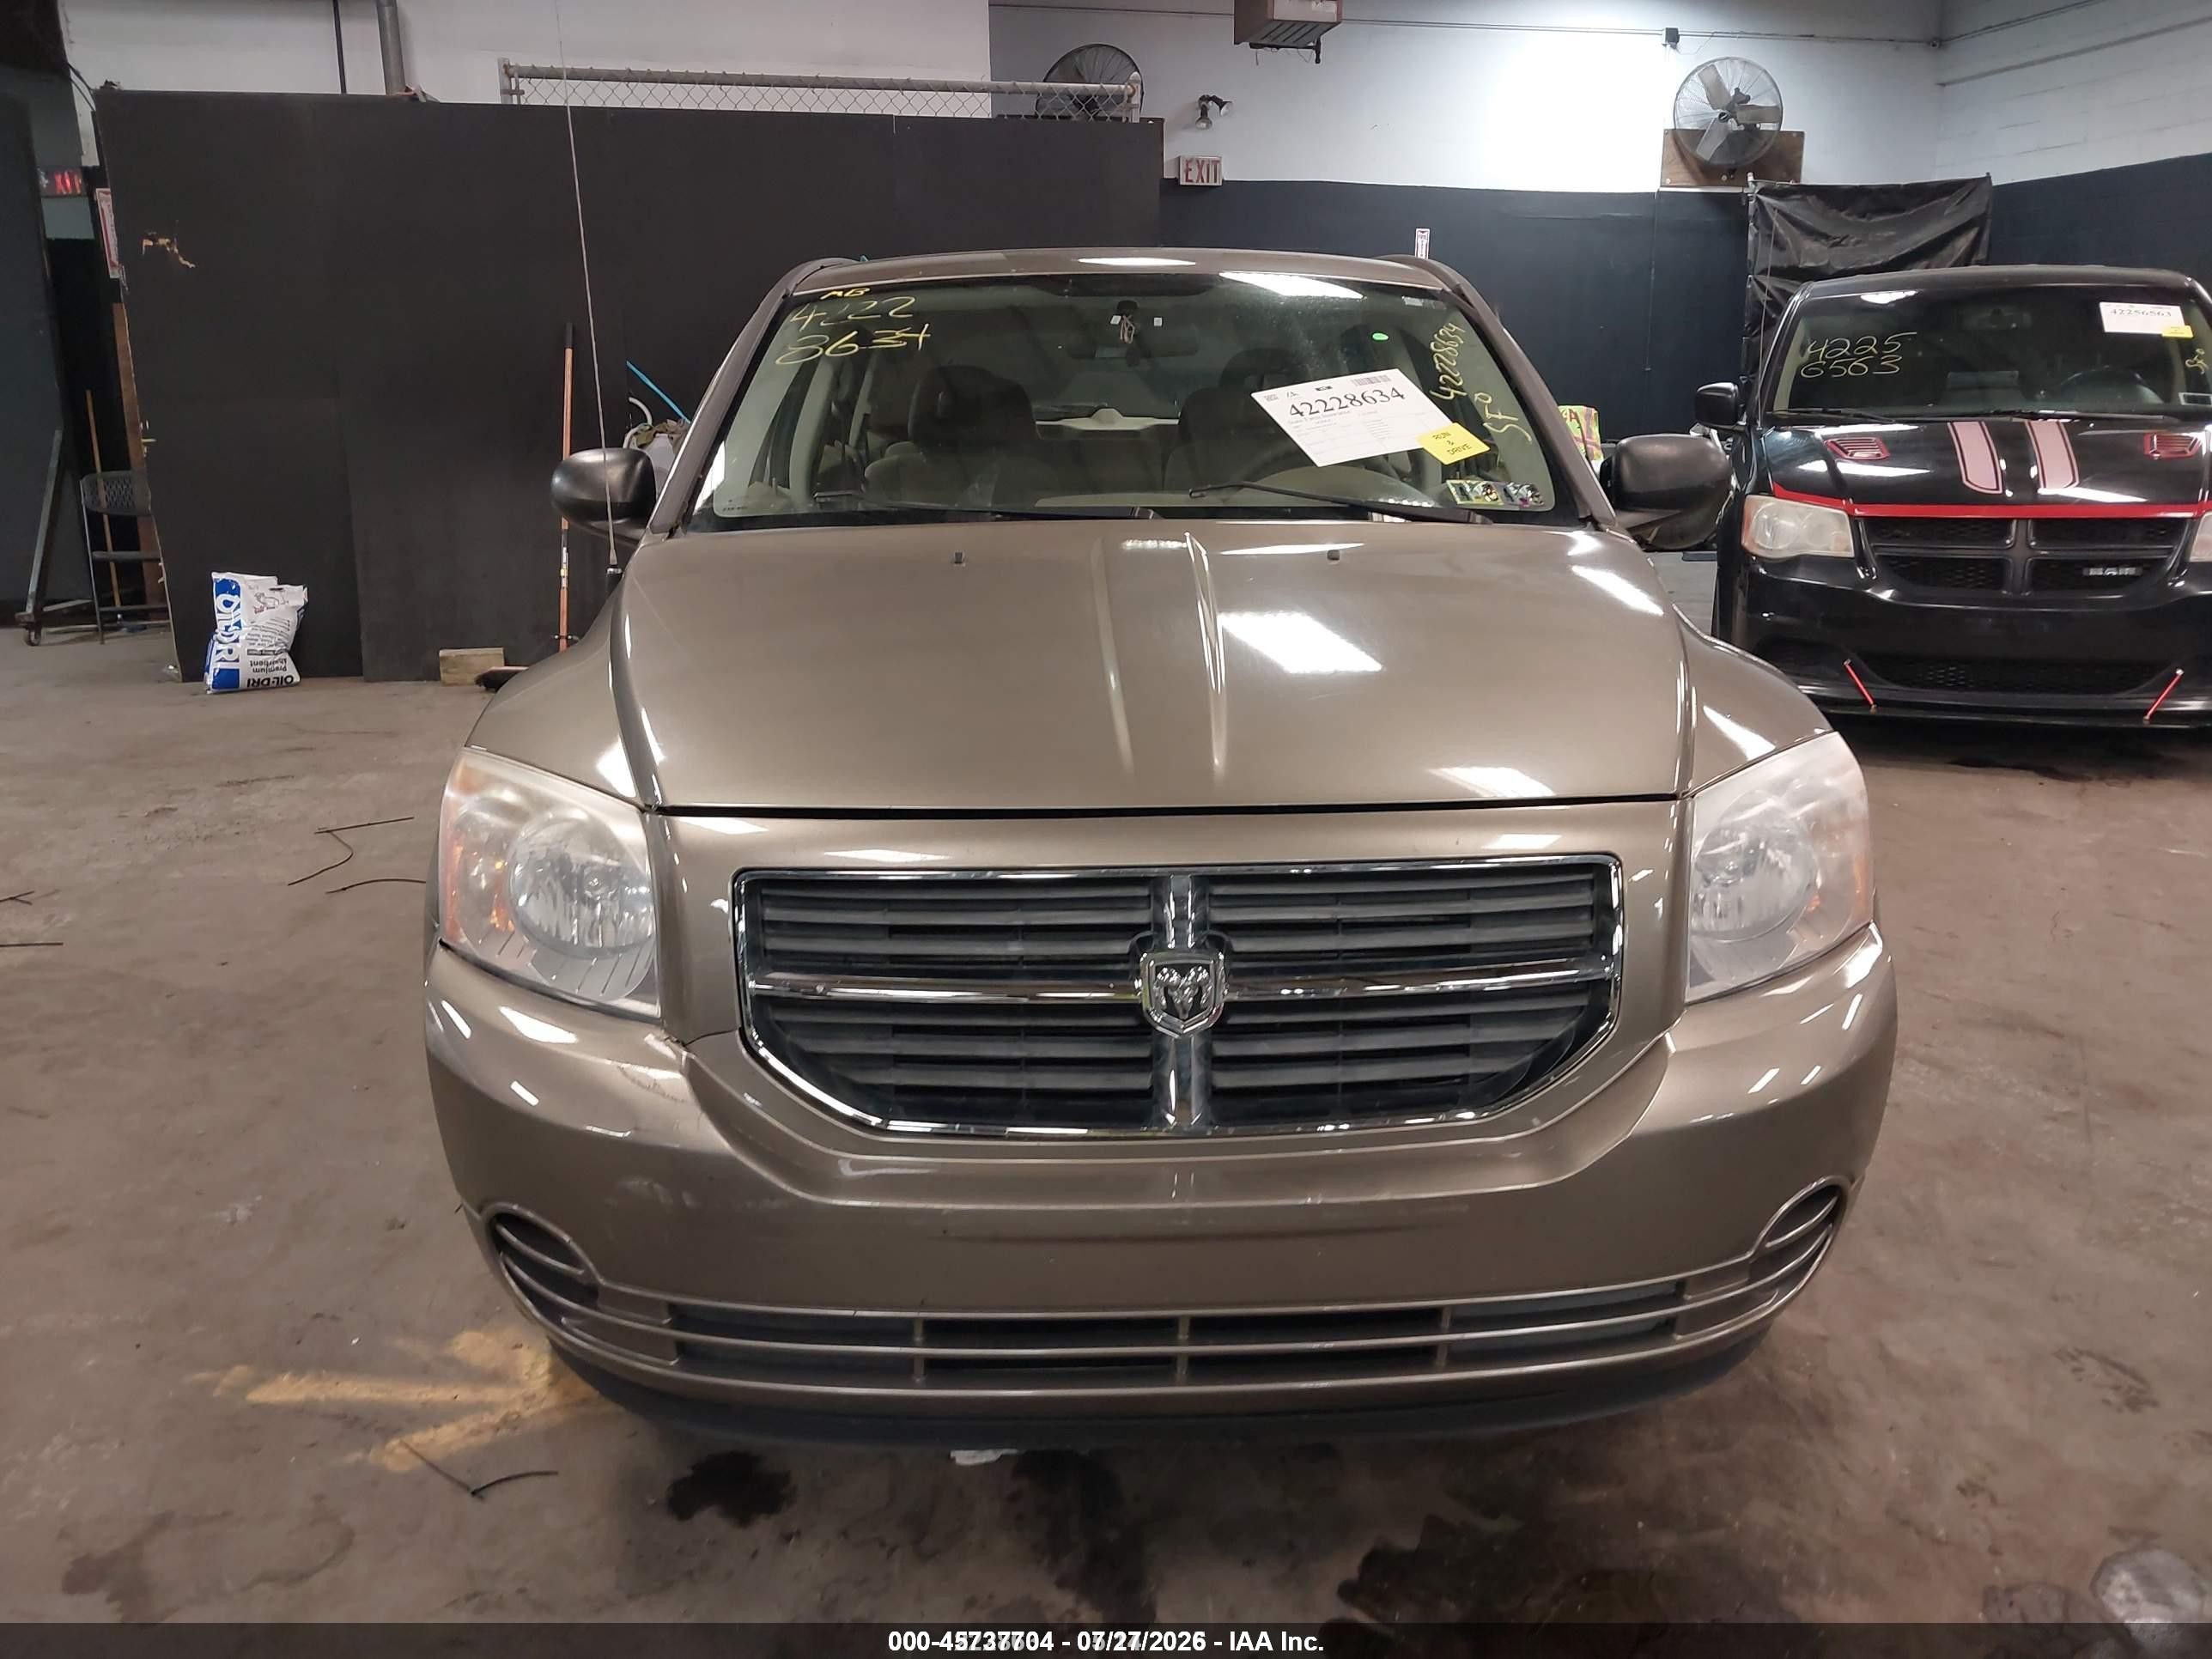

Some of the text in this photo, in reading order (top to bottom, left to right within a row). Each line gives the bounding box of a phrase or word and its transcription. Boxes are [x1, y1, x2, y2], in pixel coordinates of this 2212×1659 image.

[1185, 159, 1220, 183] EXIT
[775, 323, 932, 365] 8634
[1807, 331, 1917, 362] 4225
[1429, 322, 1468, 401] 42228634
[1800, 355, 1903, 379] 6563
[1289, 386, 1406, 417] 42228634
[1446, 443, 1474, 455] DRIVE
